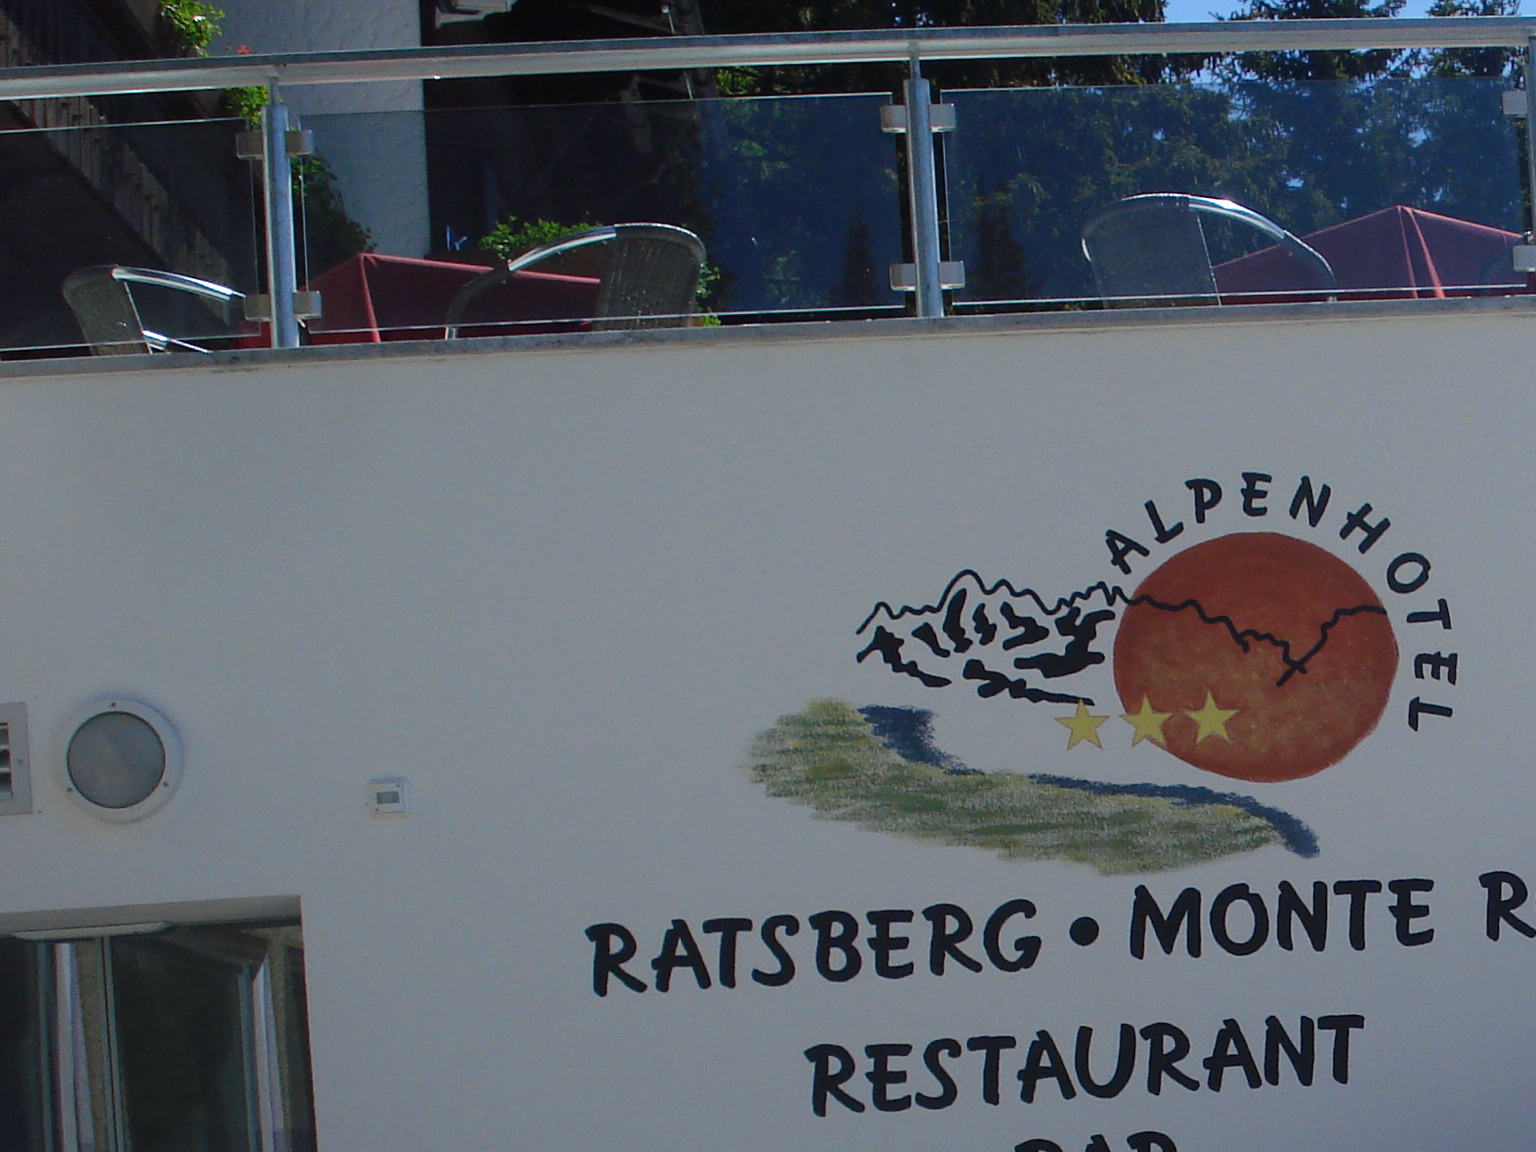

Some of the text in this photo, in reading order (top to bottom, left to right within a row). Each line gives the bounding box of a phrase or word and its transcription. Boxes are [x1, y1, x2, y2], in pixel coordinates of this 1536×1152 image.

[1104, 471, 1459, 732] ALPENHOTEL
[584, 898, 1043, 998] RATSBERG
[1129, 876, 1435, 961] MONTE
[803, 1013, 1367, 1118] RESTAURANT
